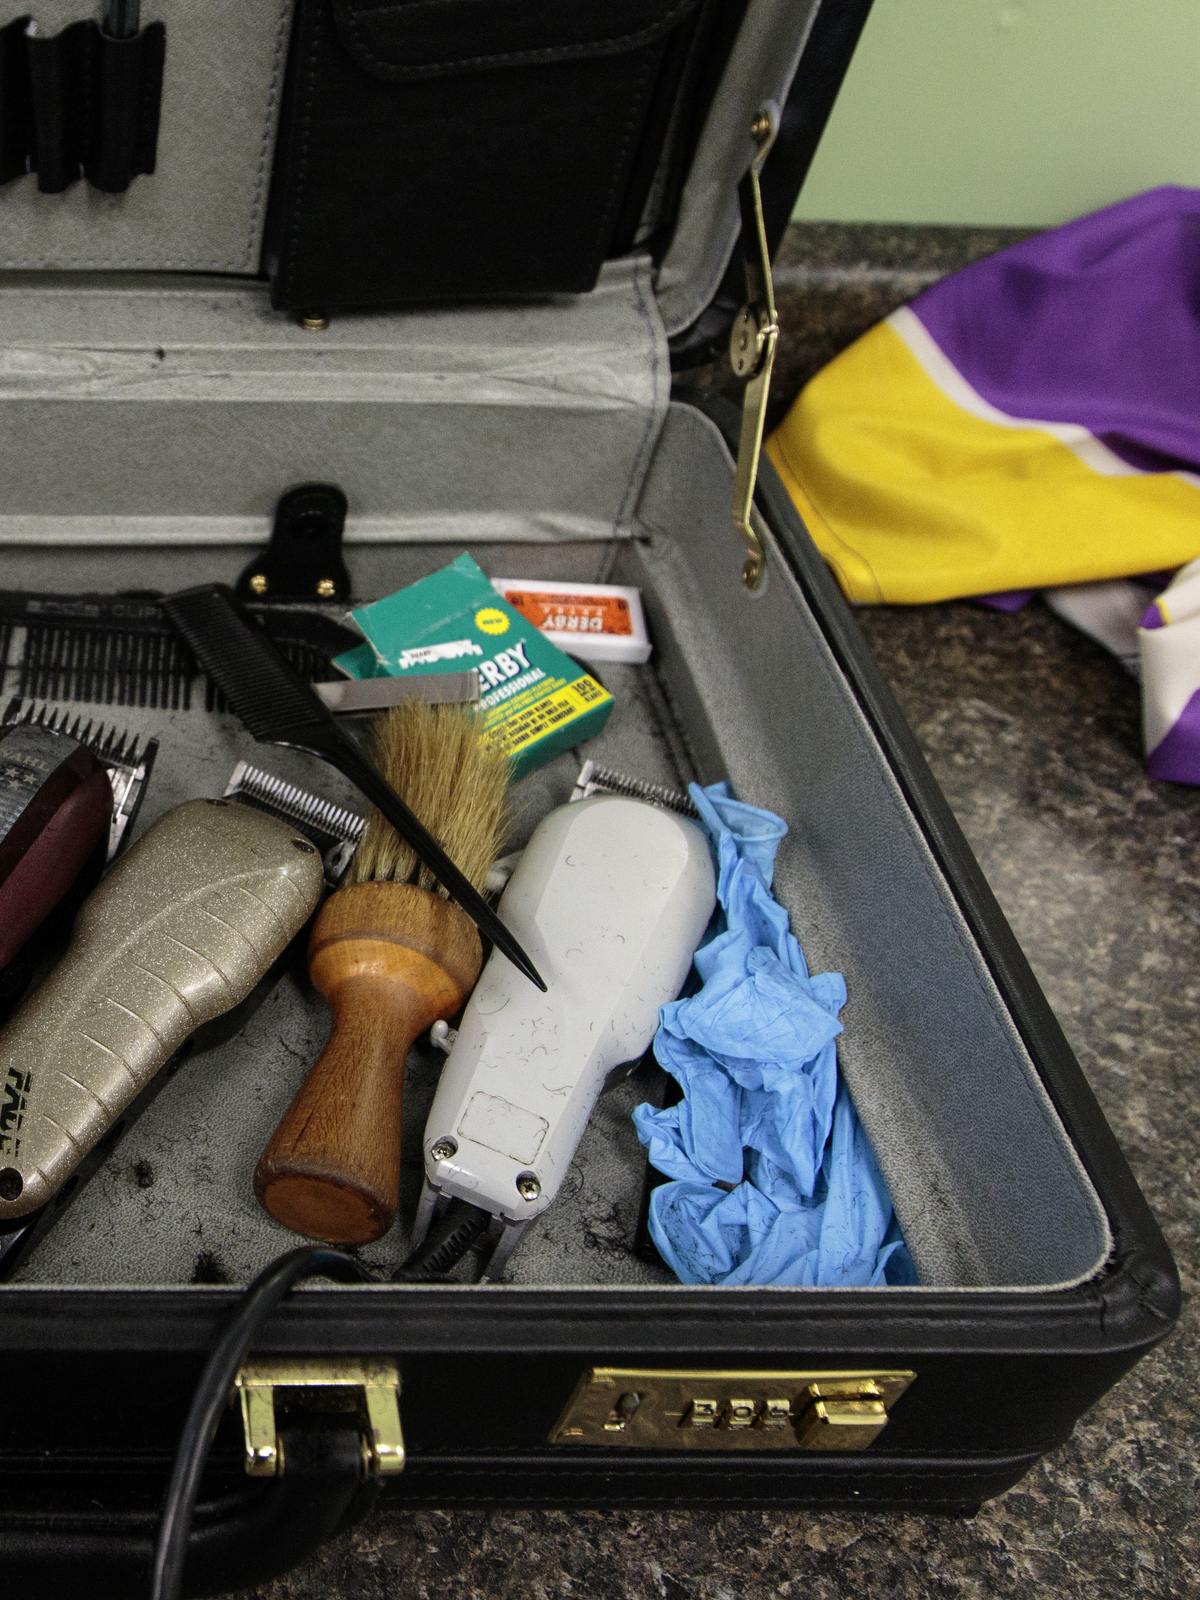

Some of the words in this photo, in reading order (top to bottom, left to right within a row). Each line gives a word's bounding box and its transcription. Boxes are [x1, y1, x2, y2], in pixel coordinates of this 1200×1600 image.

[481, 617, 505, 626] NEW
[541, 613, 604, 631] DERBY
[410, 650, 432, 660] DERBY
[471, 642, 531, 693] ERBY
